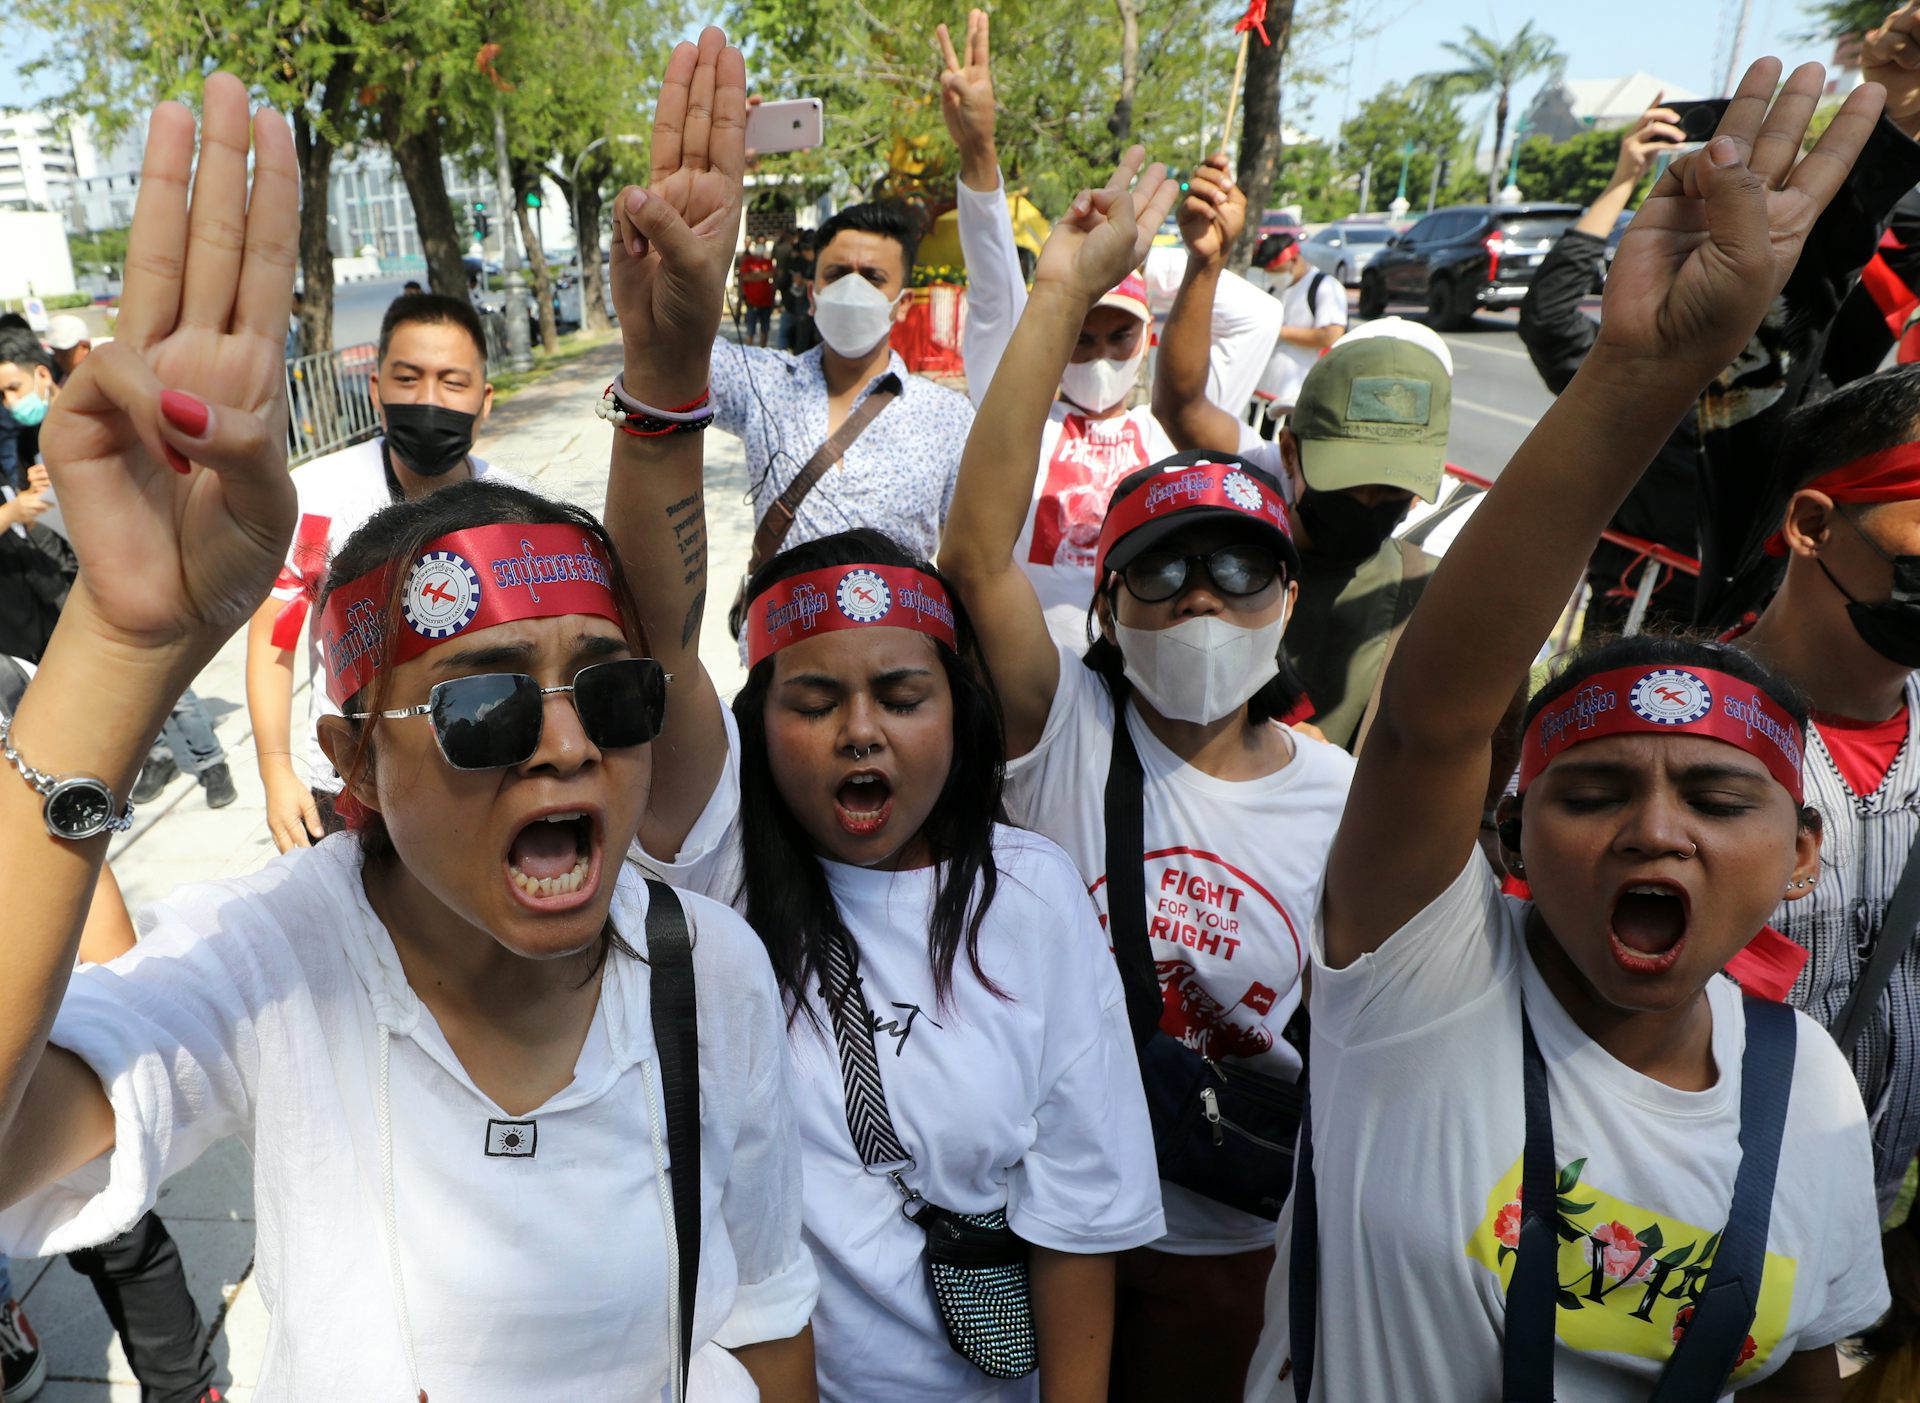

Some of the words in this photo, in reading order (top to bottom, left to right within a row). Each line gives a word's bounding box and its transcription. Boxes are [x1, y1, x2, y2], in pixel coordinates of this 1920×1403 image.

[1160, 867, 1245, 913] FIGHT
[1149, 915, 1241, 961] RIGHT
[1158, 898, 1188, 918] FOR
[1194, 909, 1240, 935] YOUR
